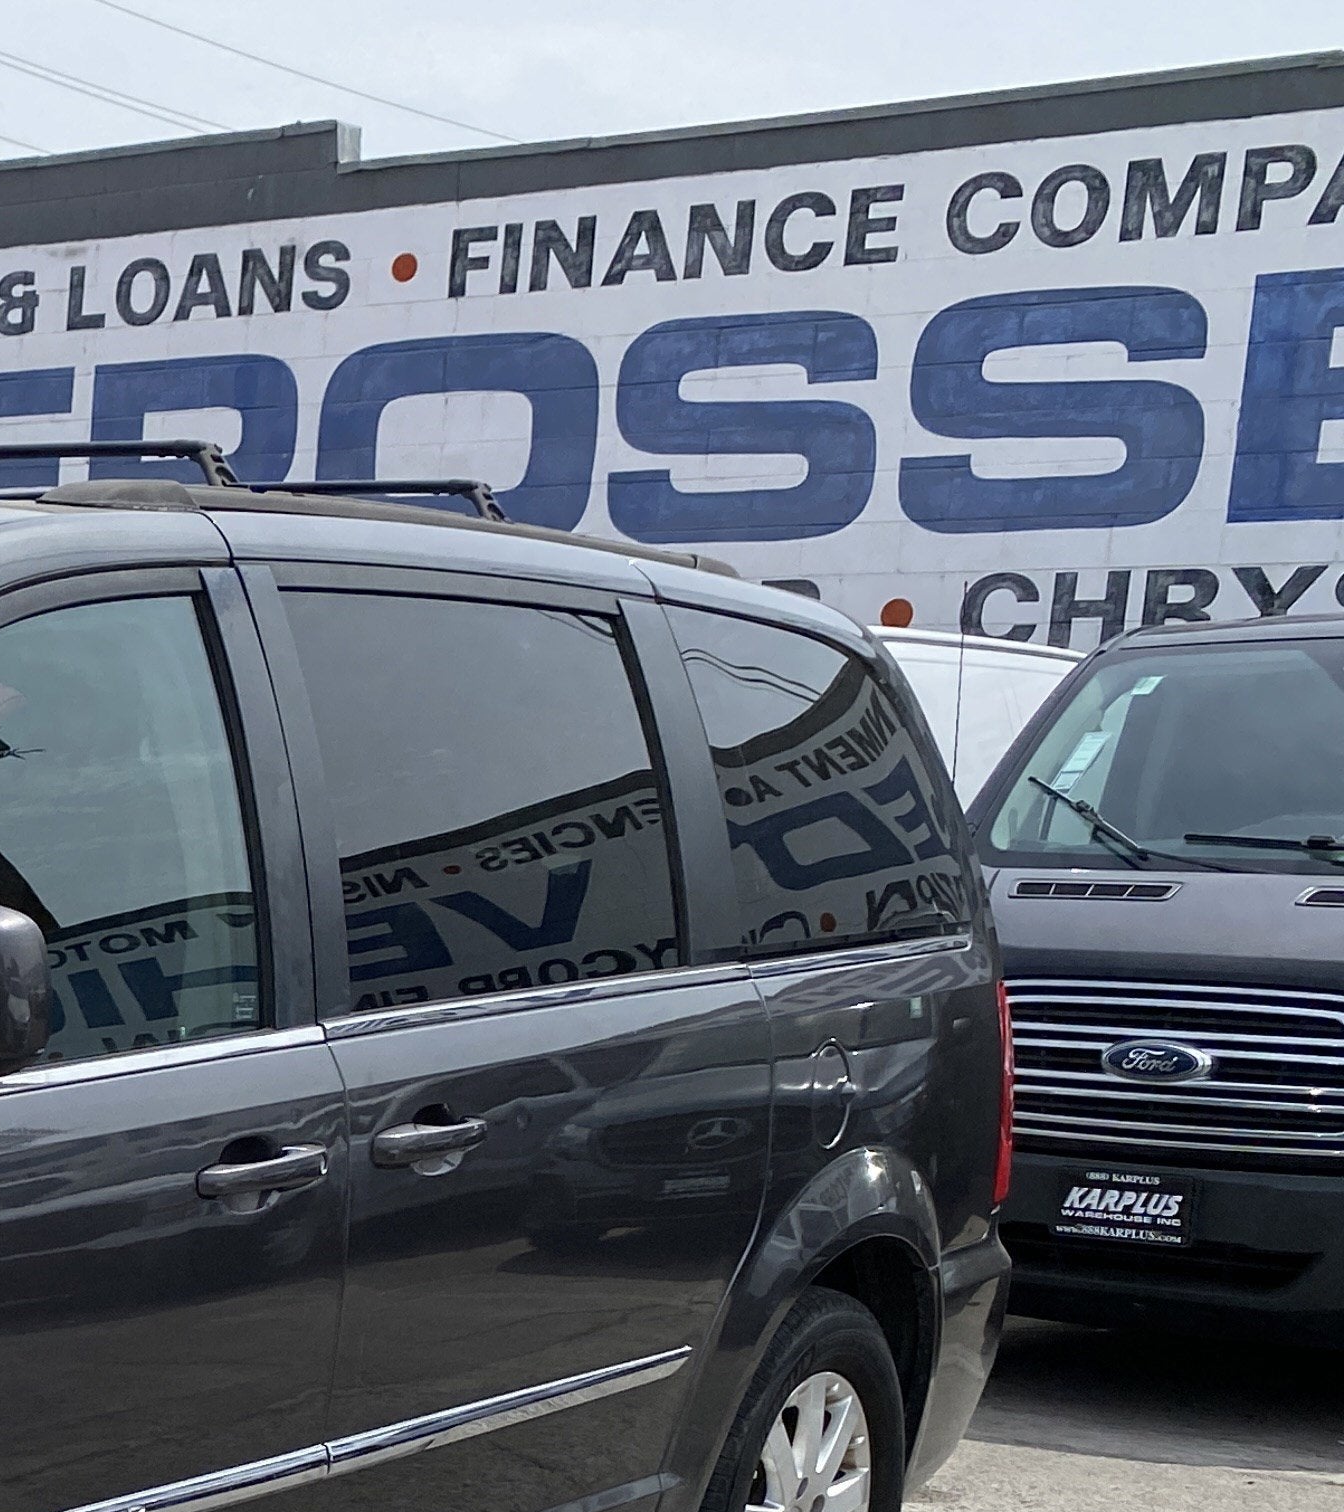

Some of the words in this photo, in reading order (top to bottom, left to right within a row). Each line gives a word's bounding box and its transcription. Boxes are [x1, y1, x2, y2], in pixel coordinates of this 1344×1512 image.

[65, 239, 351, 331] LOANS
[448, 183, 906, 298] FINANCE
[960, 564, 1344, 650] CHRY
[1121, 1047, 1177, 1073] Ford
[1112, 1173, 1161, 1186] KARPLUS
[1062, 1186, 1183, 1217] KARPLUS
[1060, 1208, 1152, 1224] WAREHOUSE
[1157, 1217, 1182, 1227] INC
